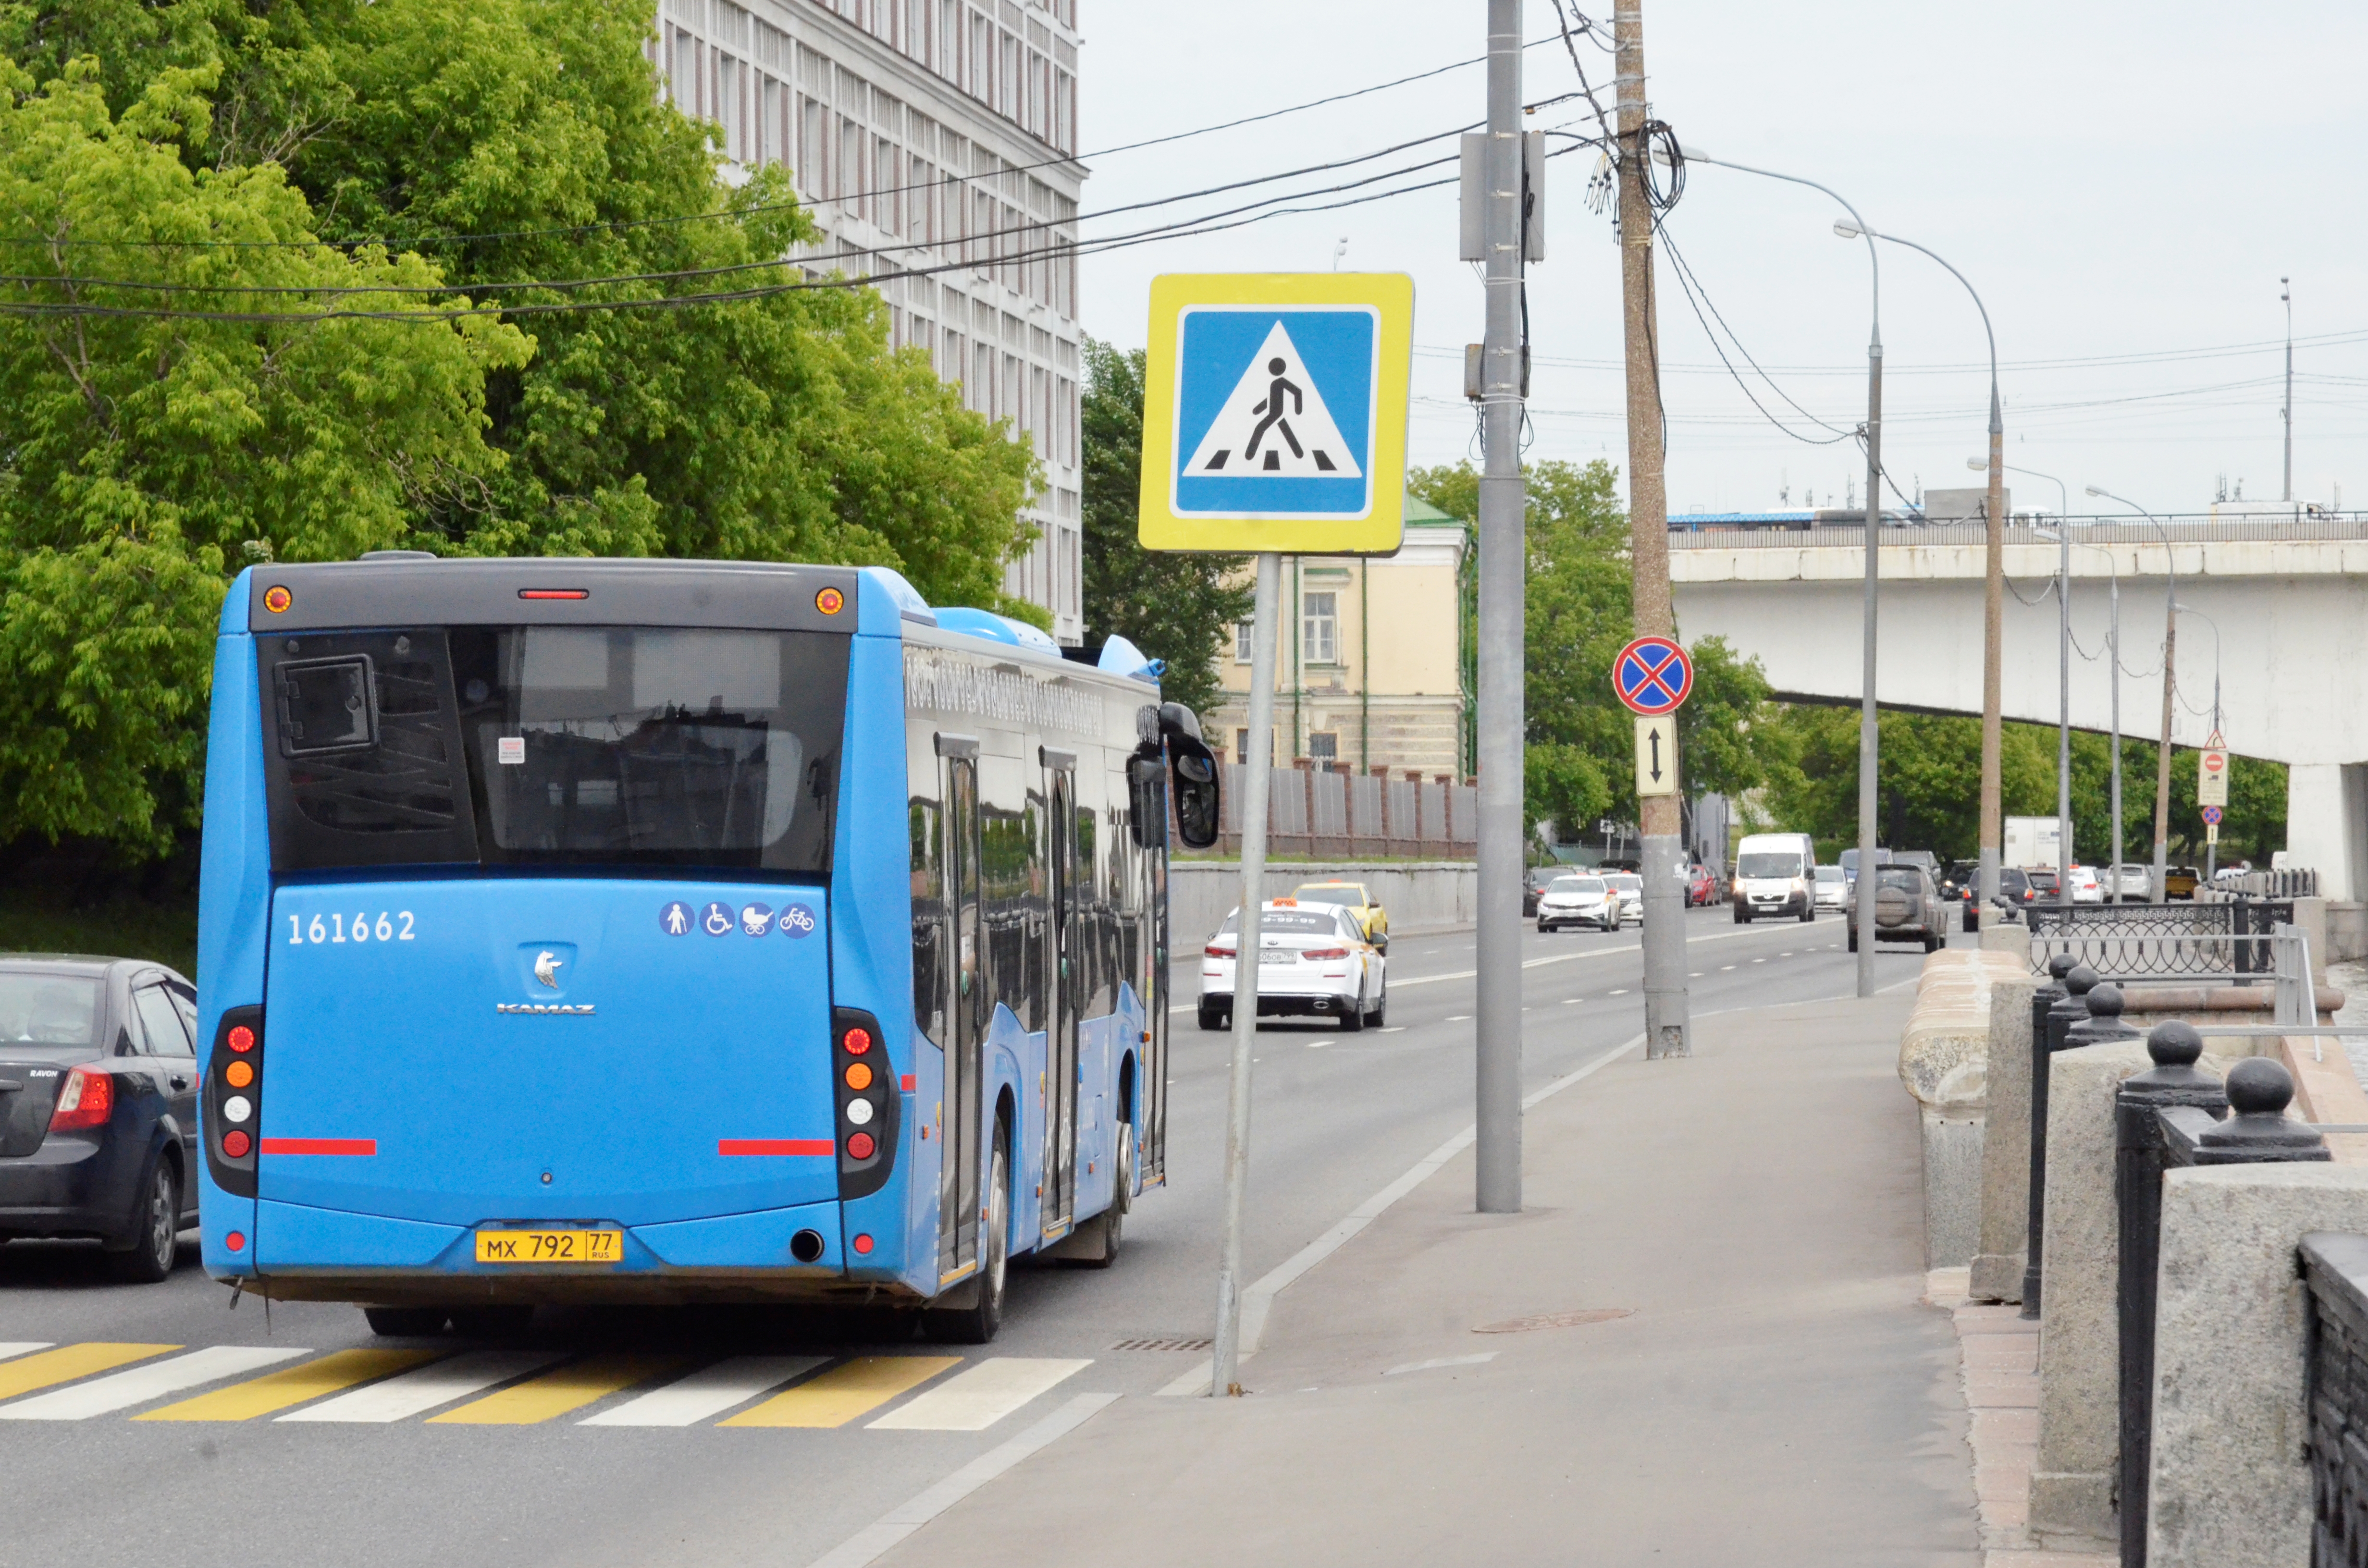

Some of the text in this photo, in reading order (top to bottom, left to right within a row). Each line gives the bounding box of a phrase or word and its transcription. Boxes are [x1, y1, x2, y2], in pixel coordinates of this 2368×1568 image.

[289, 911, 415, 944] 161662
[497, 1003, 596, 1014] KAMAZ
[530, 1235, 573, 1257] 792
[590, 1233, 612, 1250] 77
